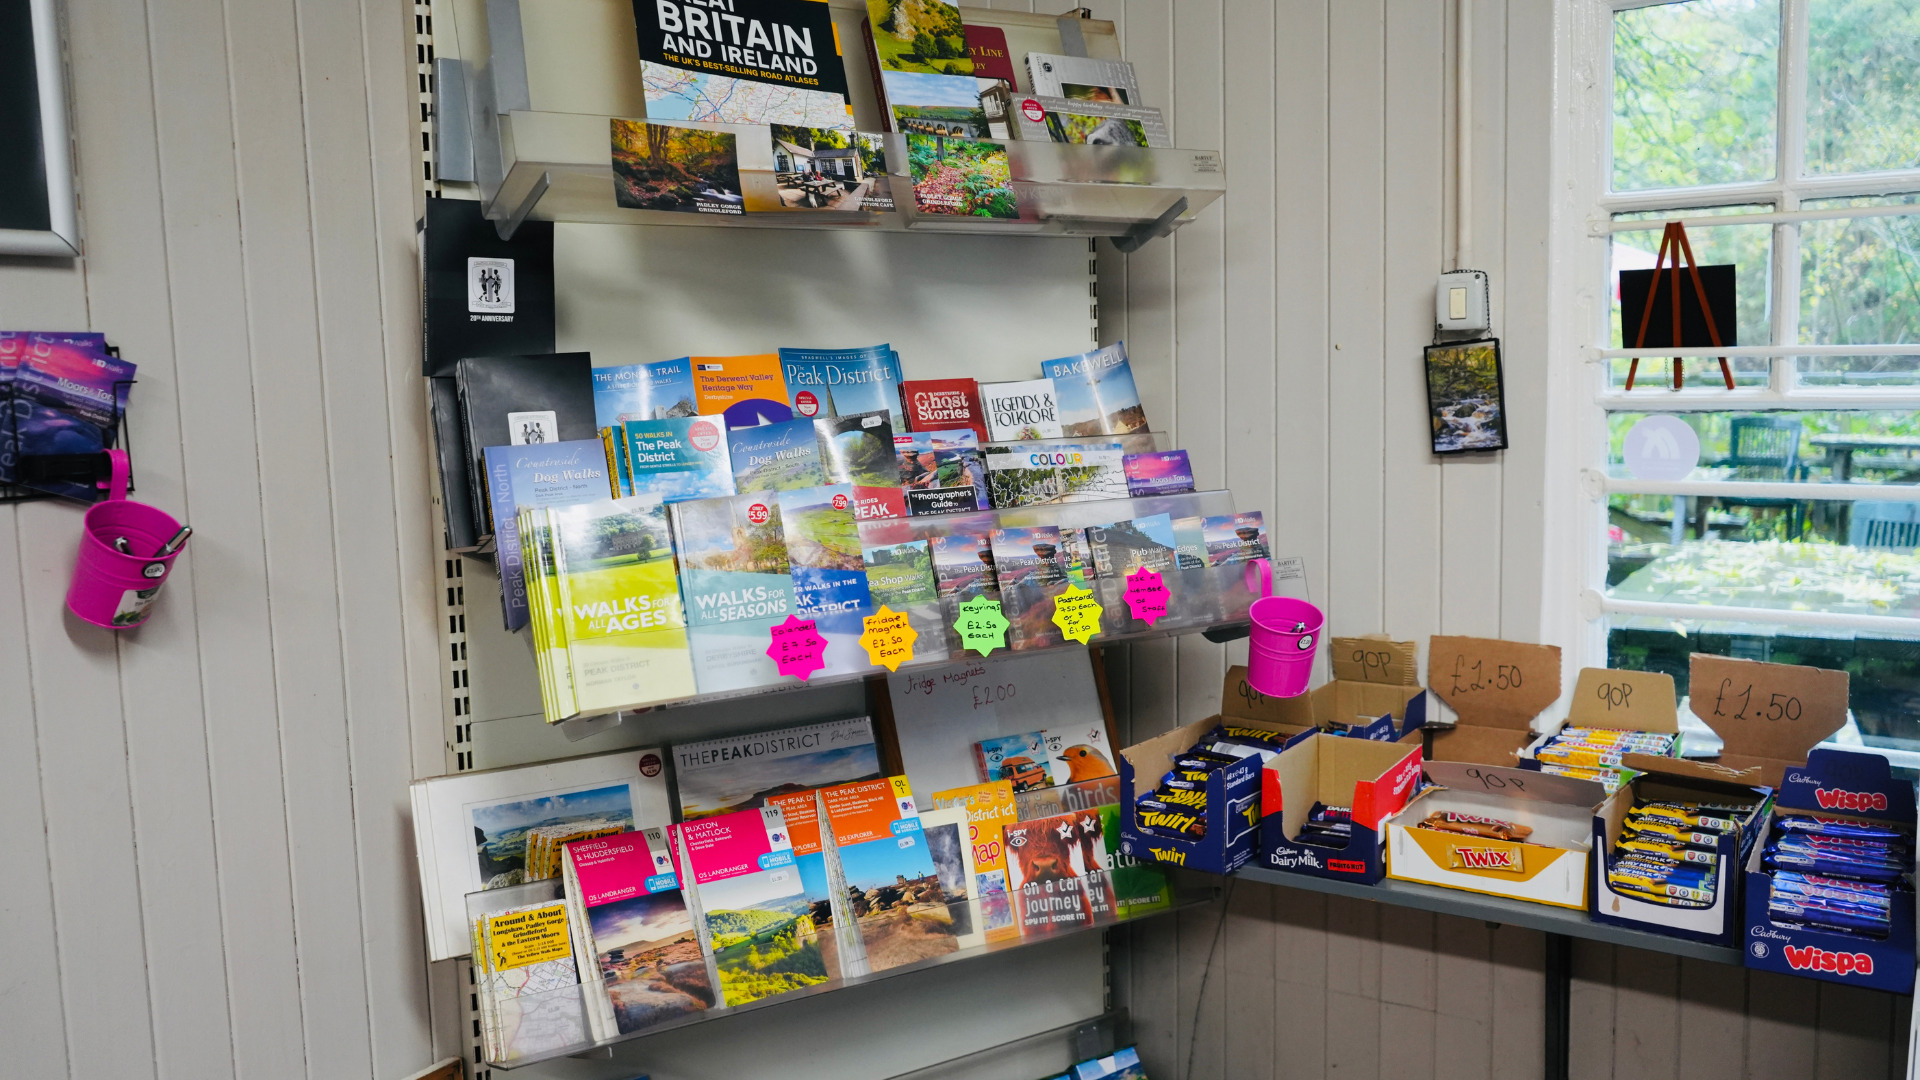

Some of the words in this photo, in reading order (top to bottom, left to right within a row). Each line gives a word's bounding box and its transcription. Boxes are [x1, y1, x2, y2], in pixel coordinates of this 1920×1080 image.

[656, 0, 815, 57] BRITAIN
[662, 33, 712, 58] AND
[720, 44, 818, 75] IRELAND
[663, 52, 680, 63] THE
[681, 56, 701, 67] UK'S
[702, 61, 758, 77] BEST-SELLING
[760, 70, 783, 81] ROAD
[784, 73, 819, 86] ATLASES
[1053, 350, 1124, 378] BAKEWELL
[594, 373, 613, 382] THE
[655, 365, 682, 376] TRAIL
[700, 375, 716, 383] The
[716, 374, 747, 383] Derwent
[749, 373, 774, 383] Valley
[787, 364, 825, 385] Peak
[825, 364, 892, 385] District
[702, 383, 736, 392] Heritage
[737, 383, 754, 392] Way
[914, 391, 969, 409] Ghost
[991, 395, 1040, 412] LEGENDS
[1043, 392, 1055, 407] &
[917, 406, 971, 421] Stories
[995, 407, 1056, 427] FOLKLORE
[634, 432, 644, 440] 50
[644, 431, 664, 439] WALKS
[635, 440, 656, 451] The
[657, 439, 682, 450] Peak
[638, 451, 676, 463] District
[749, 455, 772, 466] Dog
[775, 447, 811, 461] Walks
[1030, 453, 1083, 466] COLOUR
[493, 463, 509, 503] North
[533, 472, 558, 483] Dog
[562, 469, 601, 480] Walks
[917, 489, 973, 500] Photographer's
[854, 503, 890, 518] PEAK
[502, 517, 522, 567] District
[1176, 543, 1198, 552] Edges
[1222, 541, 1238, 549] Peak
[1238, 538, 1261, 547] District
[1131, 549, 1148, 558] Pub
[963, 565, 980, 573] Peak
[1020, 558, 1035, 566] Peak
[1035, 557, 1057, 565] District
[804, 583, 831, 592] WALKS
[842, 578, 857, 586] THE
[880, 575, 904, 586] Shop
[904, 573, 924, 582] Walks
[511, 569, 526, 609] Peak
[695, 586, 767, 610] WALKS
[768, 589, 785, 600] FOR
[574, 595, 651, 620] WALKS
[652, 597, 671, 608] FOR
[701, 609, 718, 620] ALL
[719, 599, 787, 622] SEASONS
[588, 620, 607, 630] ALL
[606, 609, 668, 634] AGES
[1223, 727, 1279, 742] Twirl
[894, 780, 906, 788] OL
[1788, 773, 1823, 787] Cadbury
[825, 789, 839, 798] THE
[839, 786, 857, 796] PEAK
[857, 782, 886, 794] DISTRICT
[1061, 784, 1118, 811] birds
[1815, 788, 1888, 813] Wispa
[765, 809, 779, 819] 119
[684, 821, 719, 833] BUXTON
[1139, 811, 1197, 834] Twirl
[594, 829, 619, 840] About
[647, 831, 661, 841] 110
[687, 833, 694, 841] &
[696, 827, 732, 840] MATLOCK
[847, 830, 874, 841] EXPLORER
[1006, 828, 1028, 838] i-SPY
[572, 841, 608, 854] SHEFFIELD
[576, 854, 583, 862] &
[584, 844, 635, 861] HUDDERSFIELD
[1148, 846, 1187, 867] Twirl
[1270, 853, 1297, 869] Dairy
[1298, 855, 1321, 868] Milk
[1455, 847, 1512, 868] Twix
[1645, 854, 1666, 863] MILK
[698, 871, 708, 879] OS
[708, 863, 749, 878] LANDRANGER
[1634, 869, 1653, 878] MILK
[1640, 862, 1660, 871] MILK
[597, 886, 637, 900] LANDRANGER
[1023, 881, 1040, 896] on
[1045, 880, 1053, 892] a
[1058, 876, 1081, 891] car
[1025, 894, 1081, 917] journey
[1128, 896, 1151, 907] SCORE
[494, 915, 526, 929] Around
[527, 913, 535, 922] &
[536, 908, 563, 921] About
[1024, 917, 1040, 926] SPY
[1039, 915, 1049, 924] IT!
[1051, 913, 1074, 923] SCORE
[1075, 911, 1086, 921] IT!
[492, 926, 525, 937] Longshaw,
[525, 922, 546, 931] Padley
[546, 917, 565, 927] Gorge
[512, 927, 548, 939] Grindleford
[1750, 925, 1792, 944] Cadbury
[506, 939, 517, 947] the
[516, 935, 540, 945] Eastern
[541, 931, 561, 940] Moors
[1784, 945, 1874, 976] Wispa
